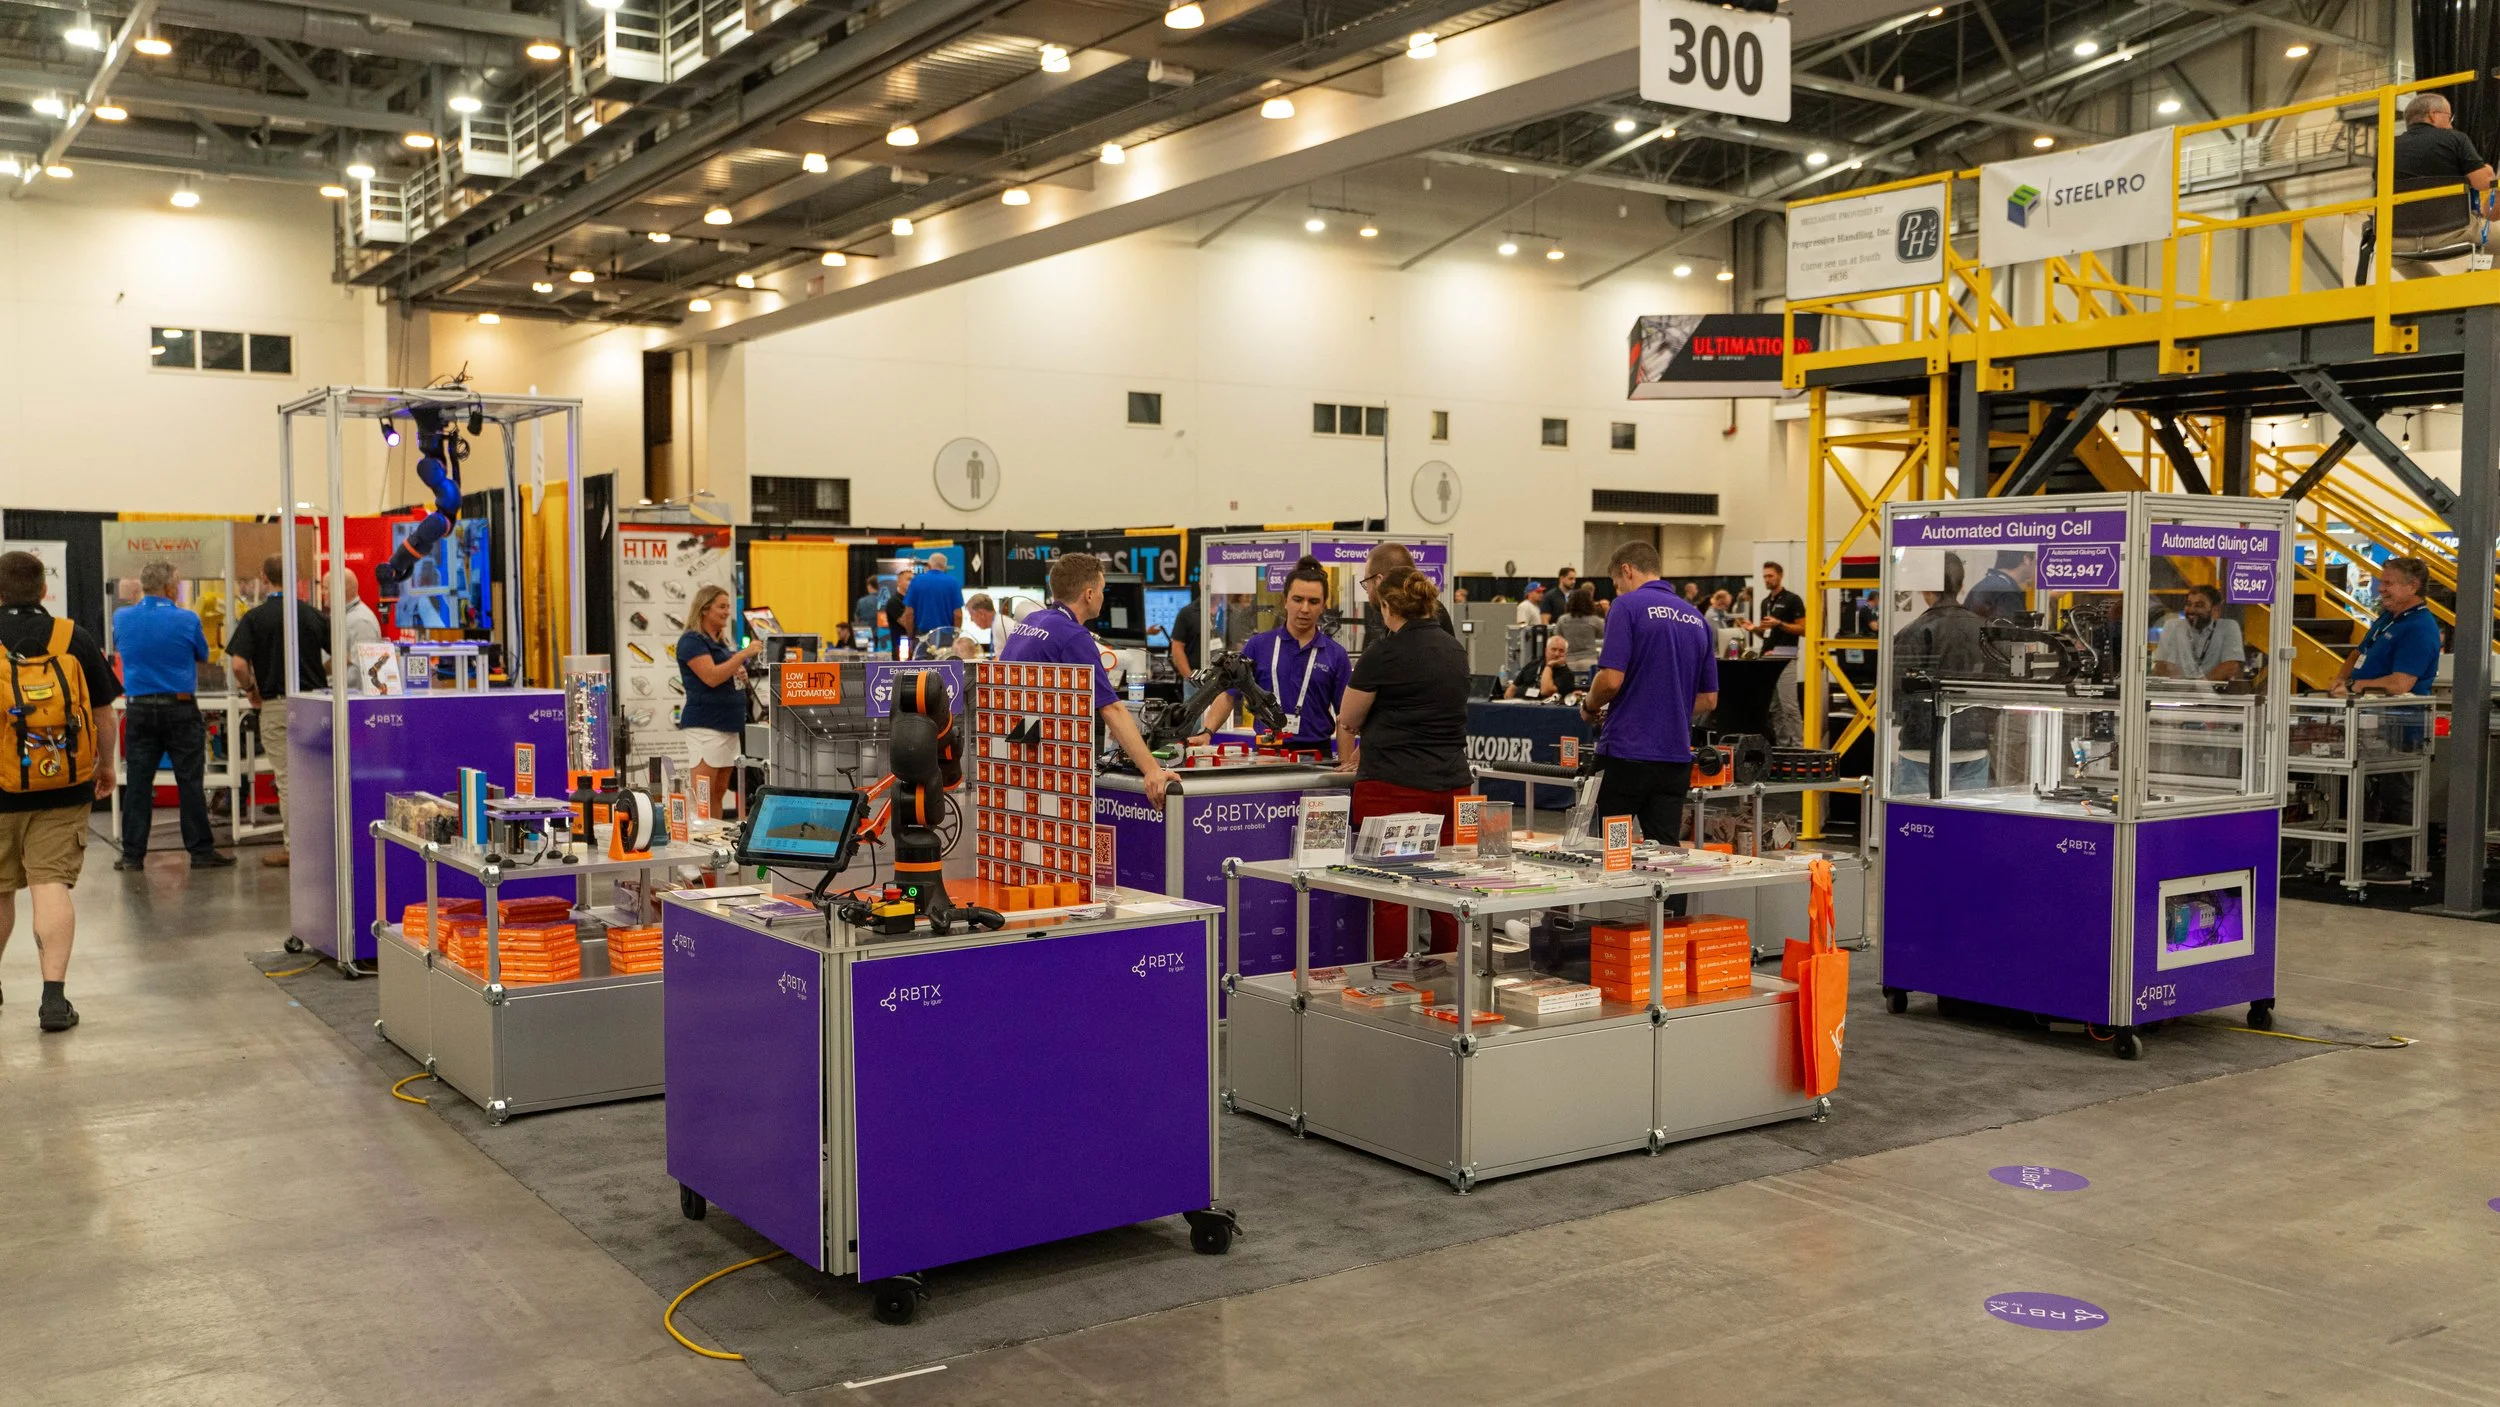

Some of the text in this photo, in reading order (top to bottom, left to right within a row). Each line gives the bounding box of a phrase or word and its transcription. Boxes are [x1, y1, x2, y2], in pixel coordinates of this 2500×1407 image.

[1668, 18, 1763, 97] 300
[2054, 174, 2145, 206] STEELPRO
[1792, 235, 1835, 249] Progressive
[1801, 261, 1822, 271] Come
[1825, 259, 1836, 268] see
[1838, 257, 1848, 266] us
[1860, 252, 1880, 264] Booth
[1922, 520, 2092, 540] Automated Gluing Cell
[624, 539, 667, 558] HTM
[2162, 533, 2268, 554] Automated Gluing Cell
[1222, 549, 1286, 561] Screwdriving Gantry
[2046, 564, 2103, 579] $32,947
[2233, 579, 2267, 593] $32,947
[1648, 606, 1703, 628] RBTX.com
[786, 681, 808, 689] COST
[786, 690, 836, 698] AUTOMATION
[377, 714, 403, 724] RBTX
[540, 709, 565, 718] RBTX
[1463, 735, 1533, 763] NCODER
[1910, 824, 1935, 834] RBTX
[2069, 840, 2096, 851] RBTX
[679, 934, 695, 951] RBTX
[1149, 952, 1184, 968] RBTX
[787, 974, 807, 993] RBTX
[900, 984, 941, 1002] RBTX
[2149, 984, 2176, 1000] RBTX
[1990, 1304, 2066, 1320] RBTX
